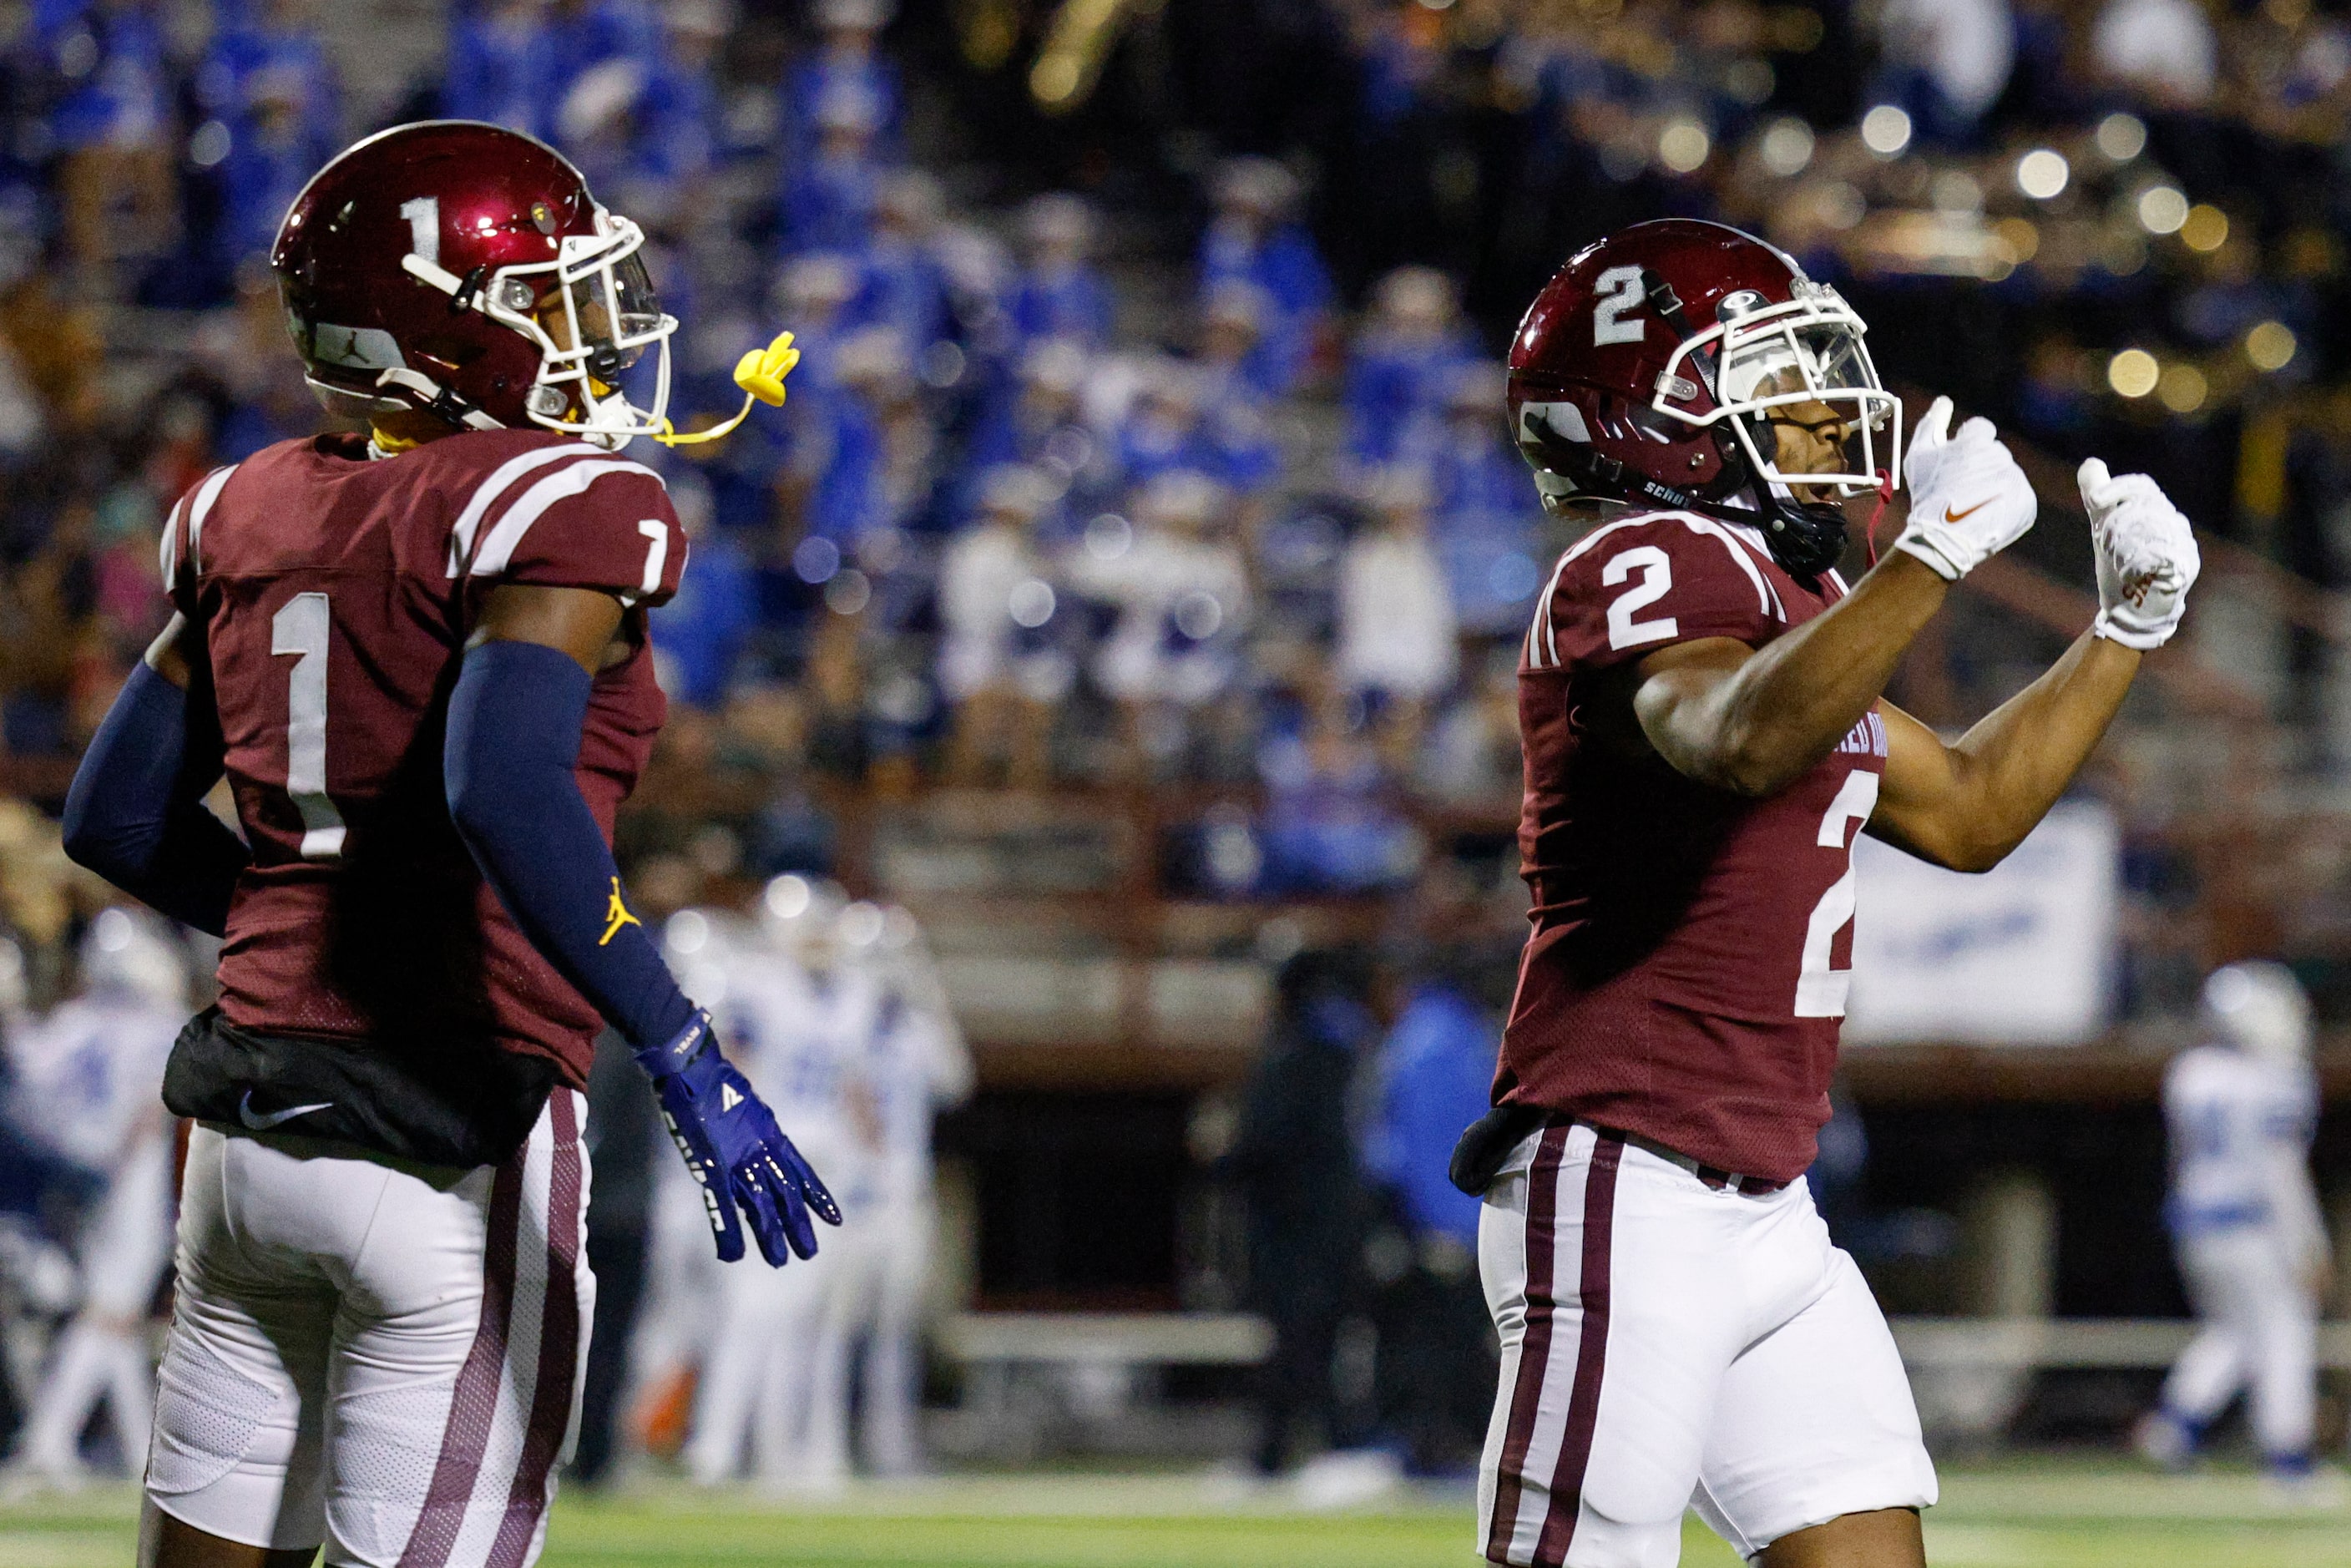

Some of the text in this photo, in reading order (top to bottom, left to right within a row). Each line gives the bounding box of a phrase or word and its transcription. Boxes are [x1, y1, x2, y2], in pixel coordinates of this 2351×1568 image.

[400, 197, 439, 267] 1
[1593, 264, 1646, 346] 2
[637, 518, 668, 595] 1
[1603, 545, 1679, 651] 2
[271, 592, 346, 857] 1
[1794, 769, 1879, 1017] 2
